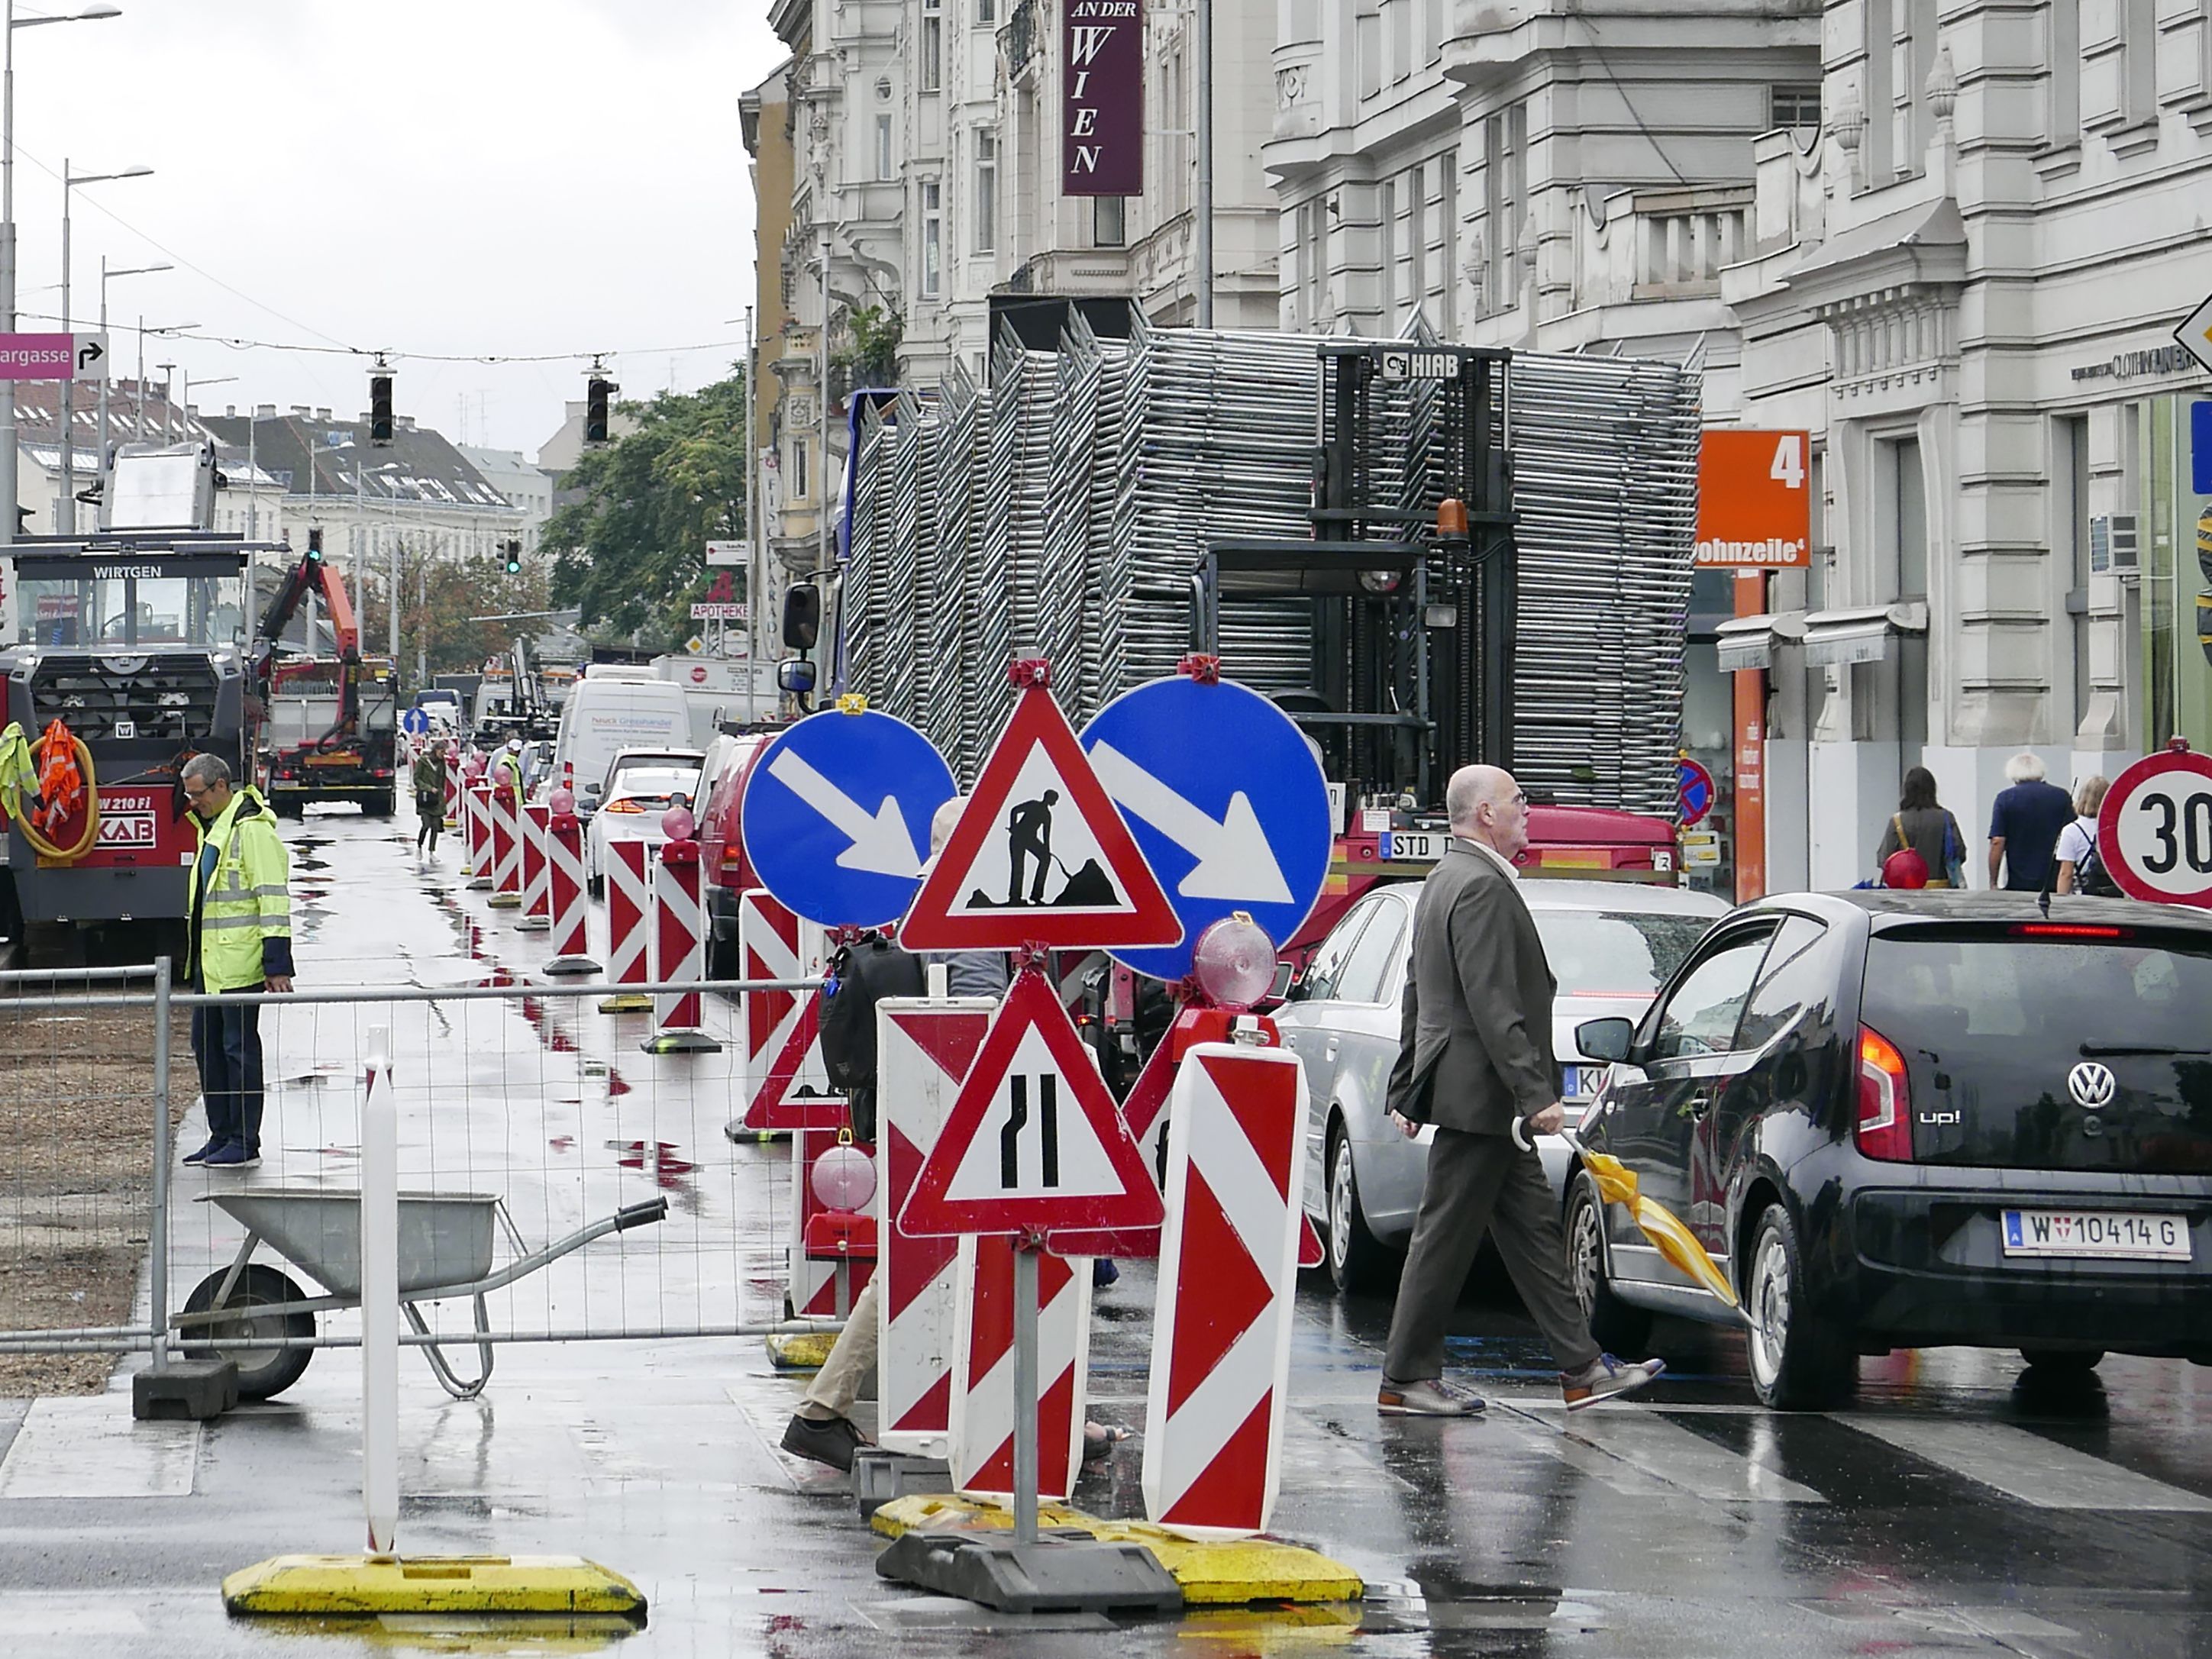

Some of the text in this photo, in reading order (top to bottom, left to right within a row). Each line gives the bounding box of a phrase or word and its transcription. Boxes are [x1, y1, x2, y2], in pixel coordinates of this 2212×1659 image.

[1070, 2, 1136, 17] AN DER
[1070, 26, 1116, 173] WIEN
[1411, 353, 1458, 377] HIAB
[1770, 435, 1805, 489] 4
[93, 566, 162, 579] WIRTGEN
[111, 798, 136, 809] 210
[137, 796, 151, 809] Fi
[2139, 792, 2212, 874] 30
[1393, 835, 1429, 856] STD
[1920, 1109, 1961, 1128] up!
[2010, 1234, 2019, 1243] A
[2031, 1215, 2175, 1246] W 10414 G
